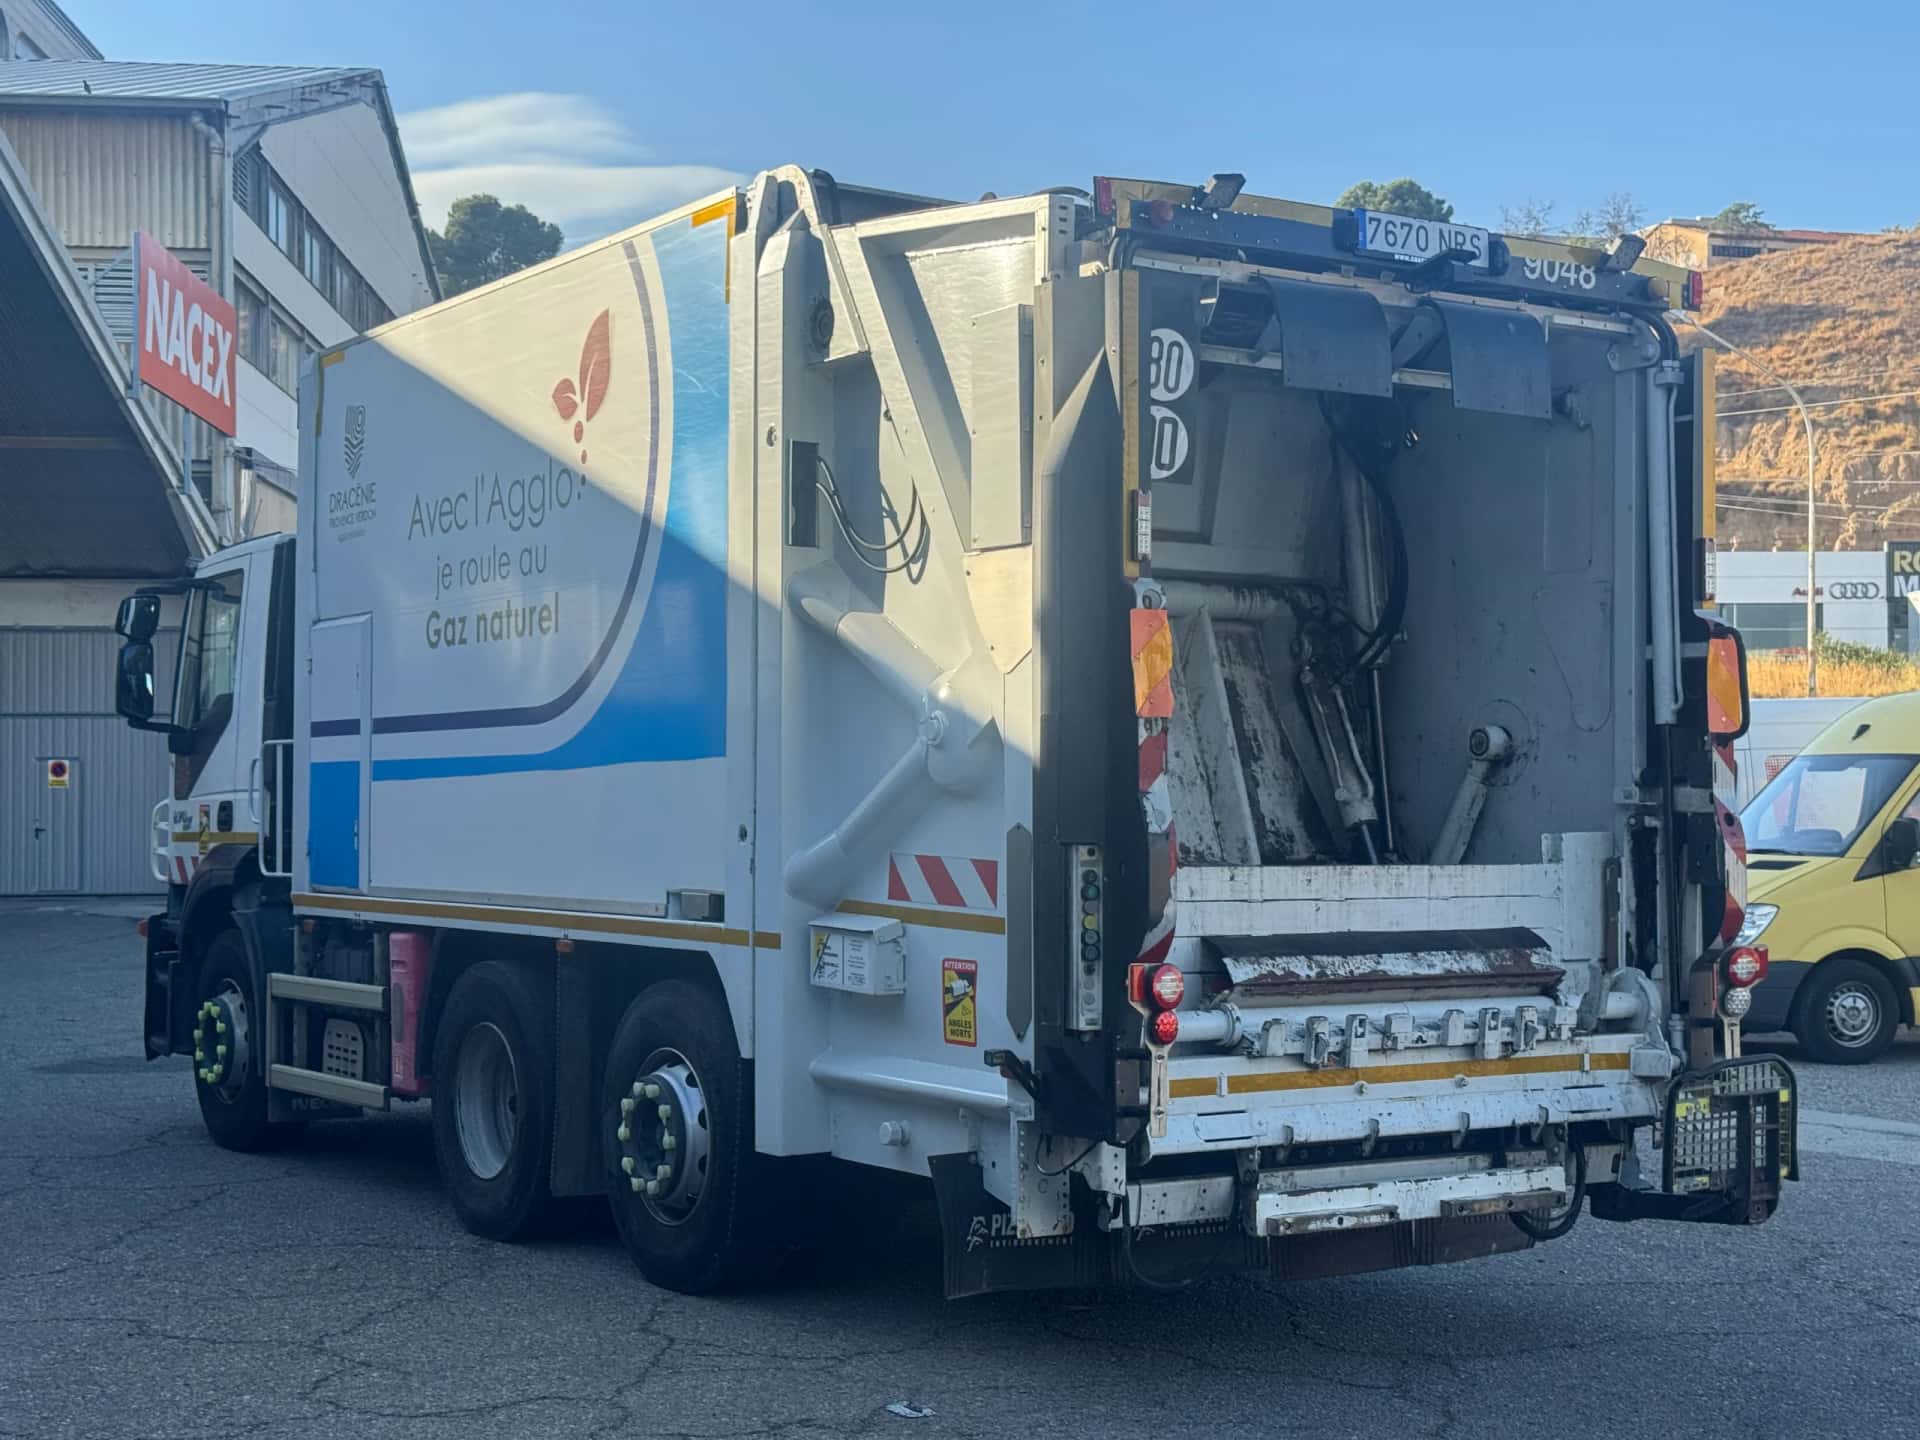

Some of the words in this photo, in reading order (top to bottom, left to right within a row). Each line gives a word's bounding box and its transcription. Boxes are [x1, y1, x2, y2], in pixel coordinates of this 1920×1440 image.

[1368, 216, 1429, 252] 7670
[1523, 256, 1596, 290] 9048
[145, 266, 233, 407] NACEX
[1151, 413, 1179, 472] 0
[408, 493, 469, 541] Avec
[435, 555, 453, 600] je
[459, 543, 511, 587] roule
[519, 544, 547, 576] au
[426, 610, 467, 649] Gaz
[476, 591, 559, 643] naturel
[944, 960, 976, 971] ATTENTION
[948, 1018, 972, 1030] ANGLES
